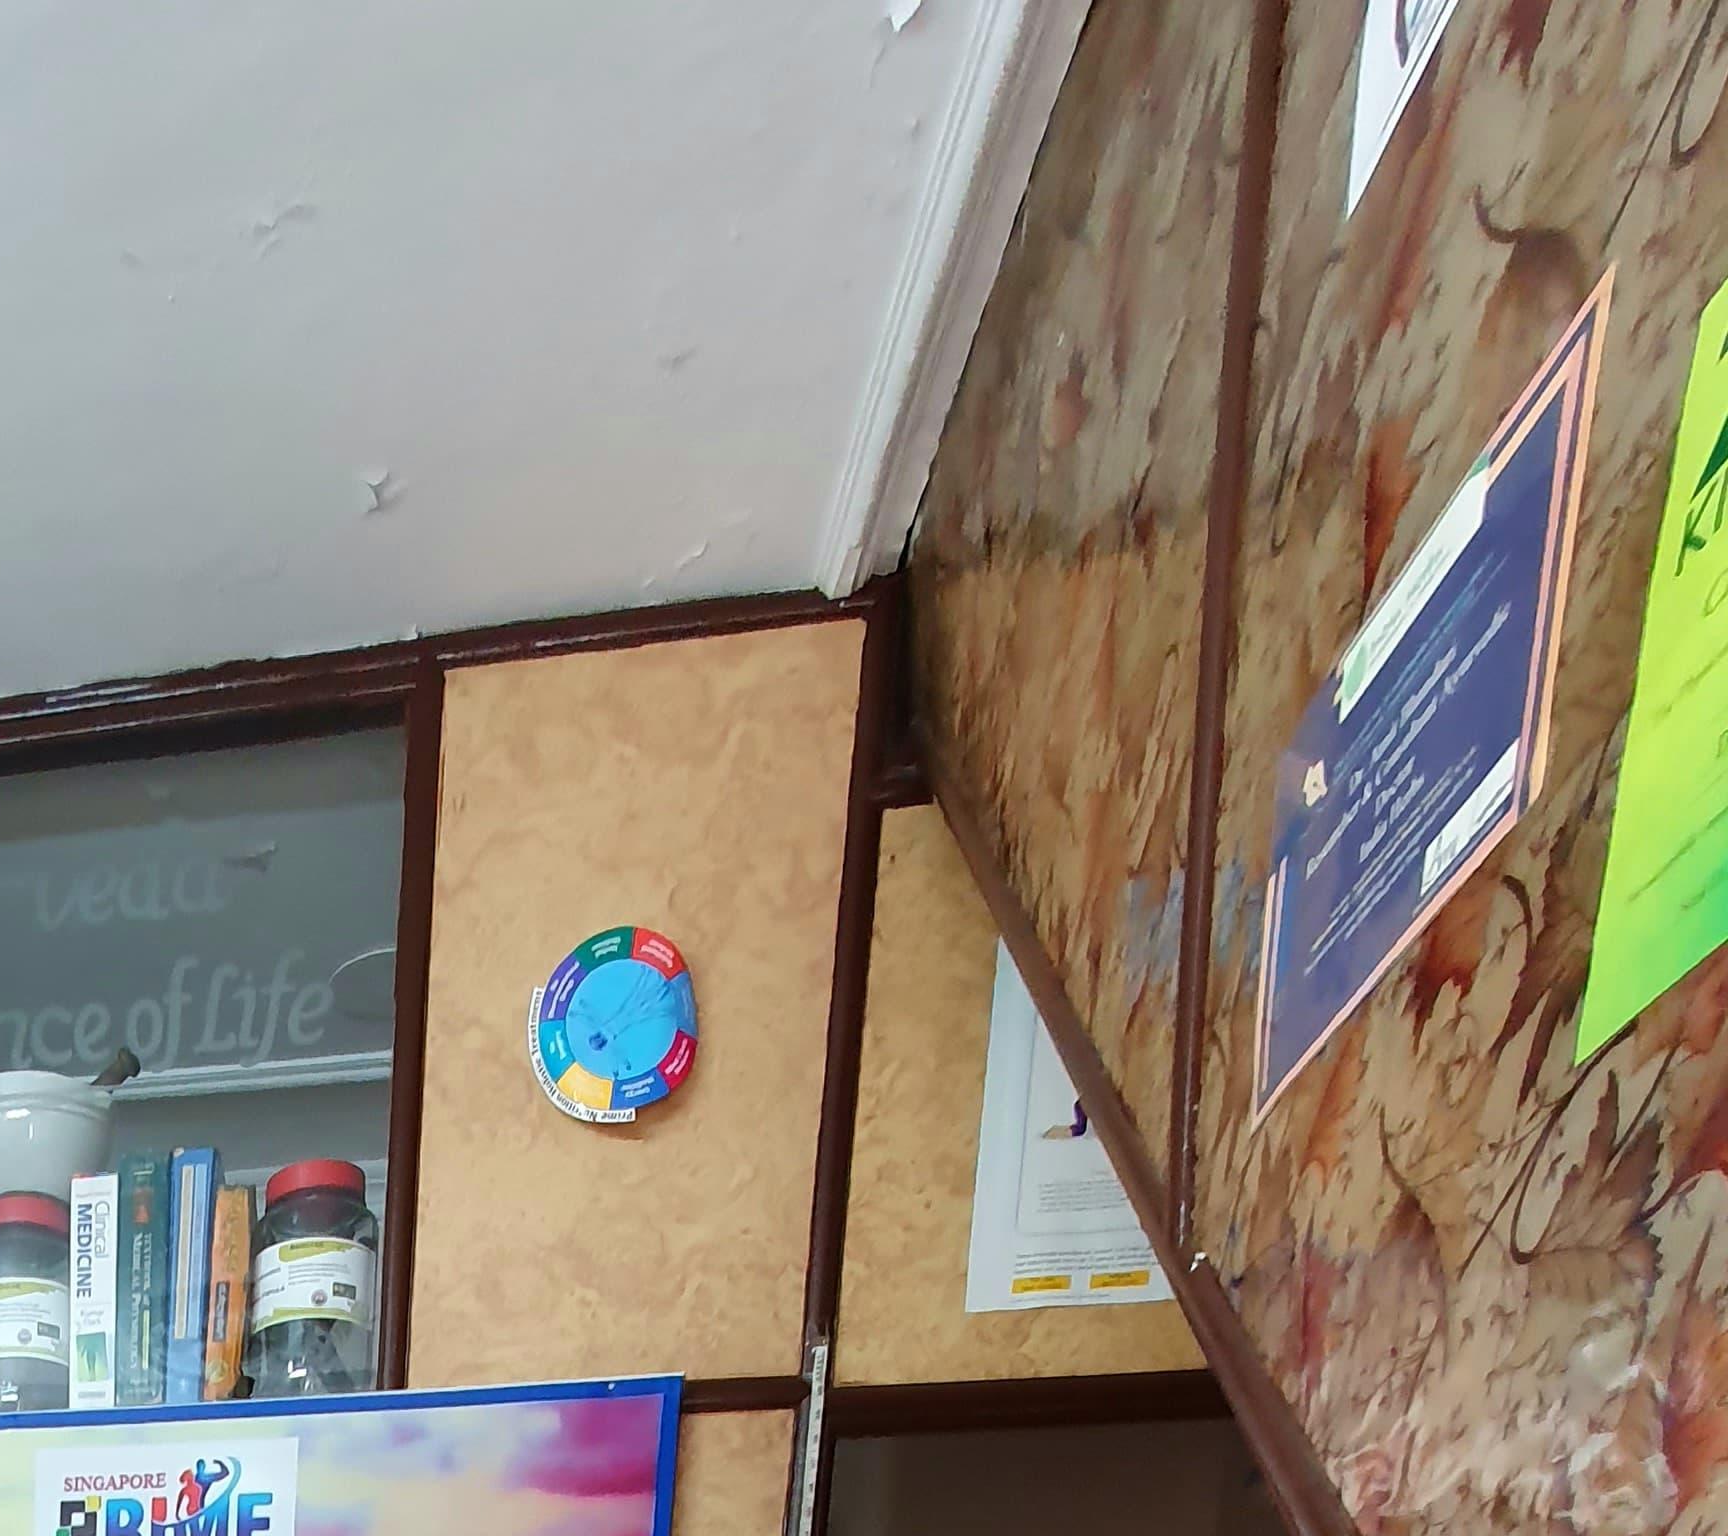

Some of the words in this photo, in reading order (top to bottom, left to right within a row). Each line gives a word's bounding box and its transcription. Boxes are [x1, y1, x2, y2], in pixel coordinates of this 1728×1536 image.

[120, 957, 204, 1075] of
[202, 959, 335, 1069] Life
[556, 1093, 598, 1121] Nurition
[75, 1203, 93, 1300] MEDICINE
[94, 1199, 110, 1260] Clinical
[63, 1471, 167, 1493] SINGAPORE
